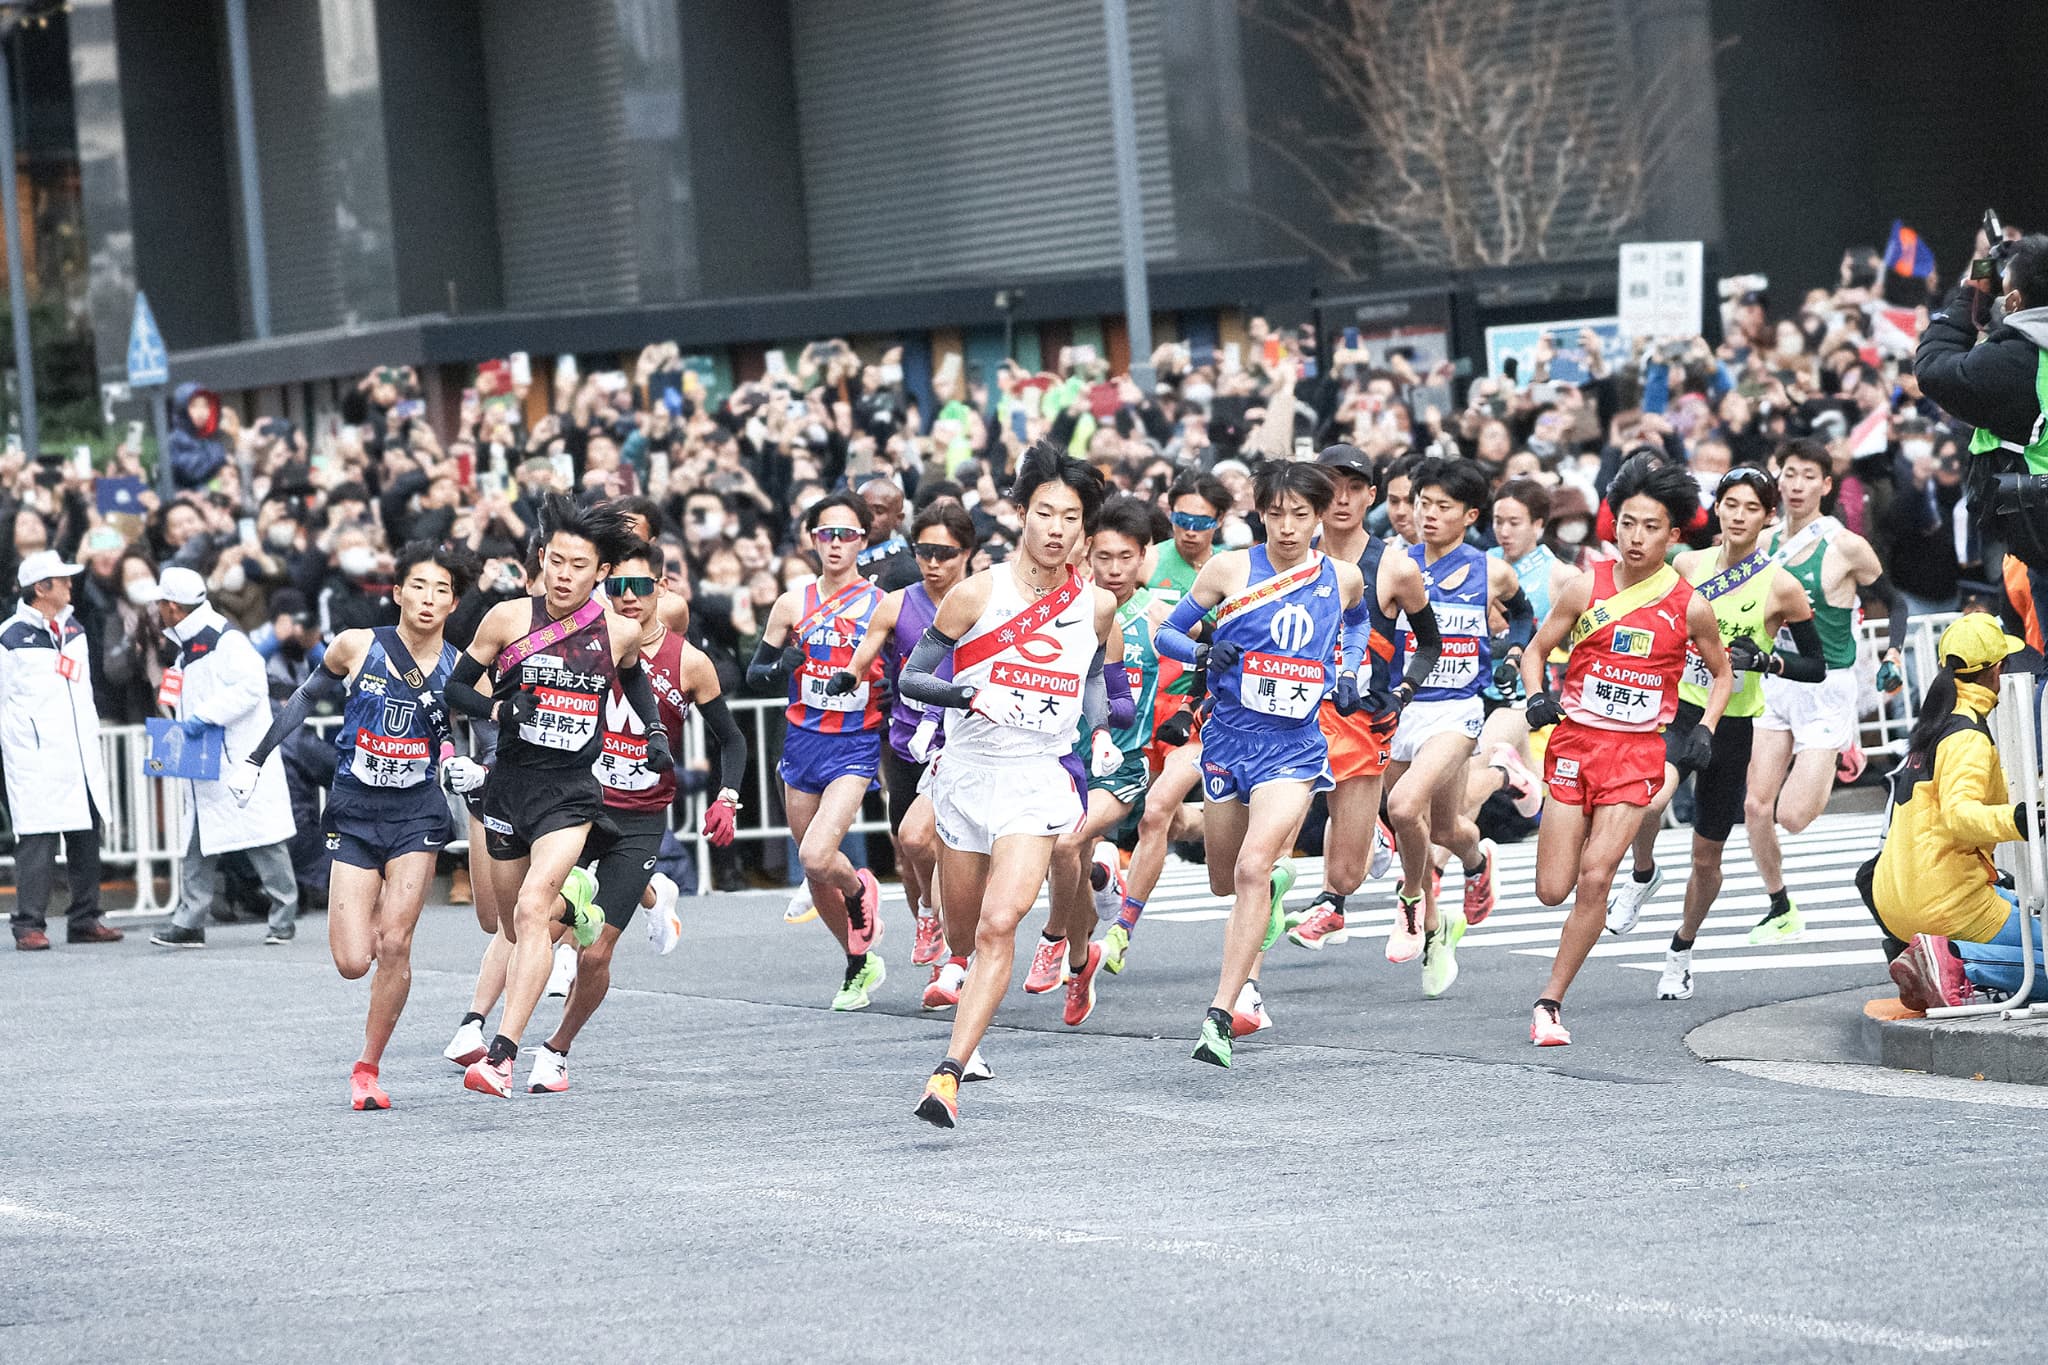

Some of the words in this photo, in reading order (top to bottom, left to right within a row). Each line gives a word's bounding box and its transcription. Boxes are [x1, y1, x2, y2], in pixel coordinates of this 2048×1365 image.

[997, 590, 1070, 643] 中央大学
[522, 666, 606, 692] 国学院大学
[1262, 659, 1322, 680] SAPPORO
[1604, 665, 1662, 687] SAPPORO
[1012, 670, 1078, 693] SAPPORO
[540, 692, 597, 712] SAPPORO
[1595, 681, 1649, 708] 城西大
[1268, 699, 1294, 716] 5-1
[1606, 703, 1631, 720] 9-1
[371, 740, 426, 756] SAPPORO
[538, 731, 571, 749] 4-11
[365, 754, 416, 775] 東洋大
[373, 775, 405, 787] 10-1
[610, 774, 634, 789] 6-1
